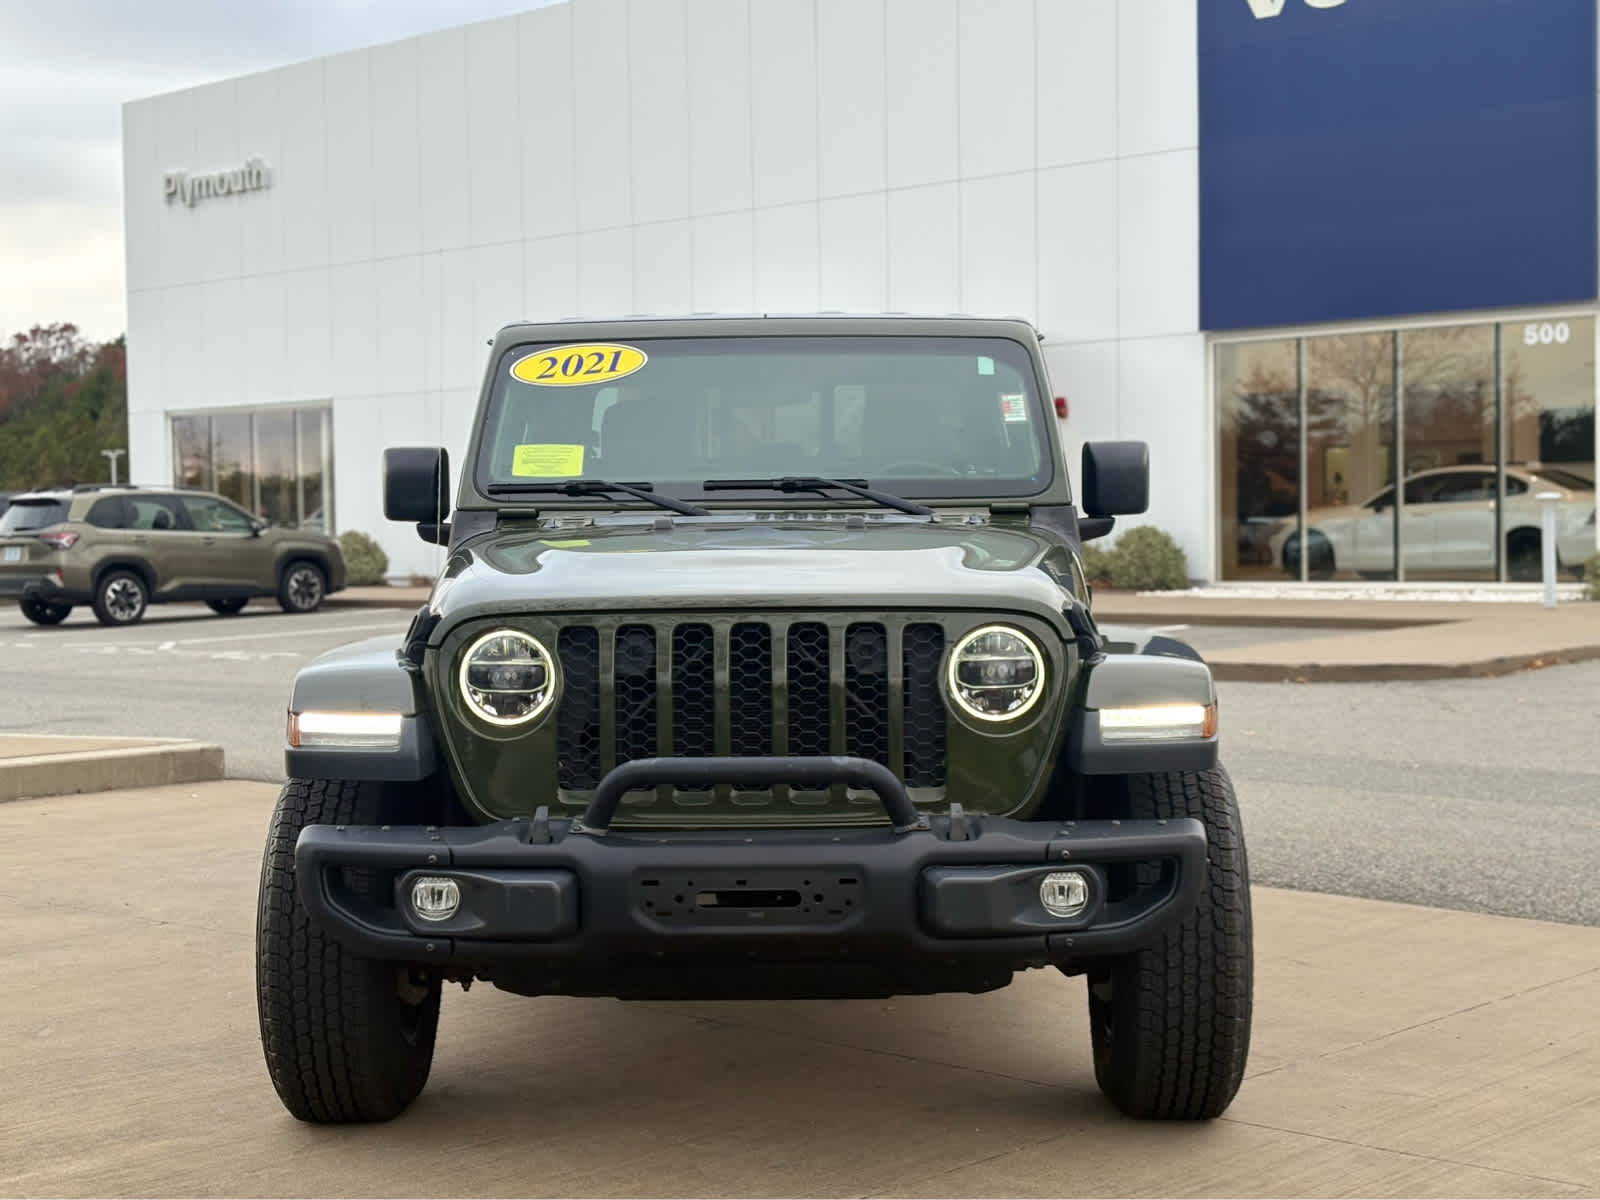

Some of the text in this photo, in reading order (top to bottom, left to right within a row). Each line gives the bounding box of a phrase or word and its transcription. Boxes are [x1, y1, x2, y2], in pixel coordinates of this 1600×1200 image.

[162, 158, 269, 208] Plymouth
[1524, 322, 1570, 345] 500
[535, 350, 623, 379] 2021
